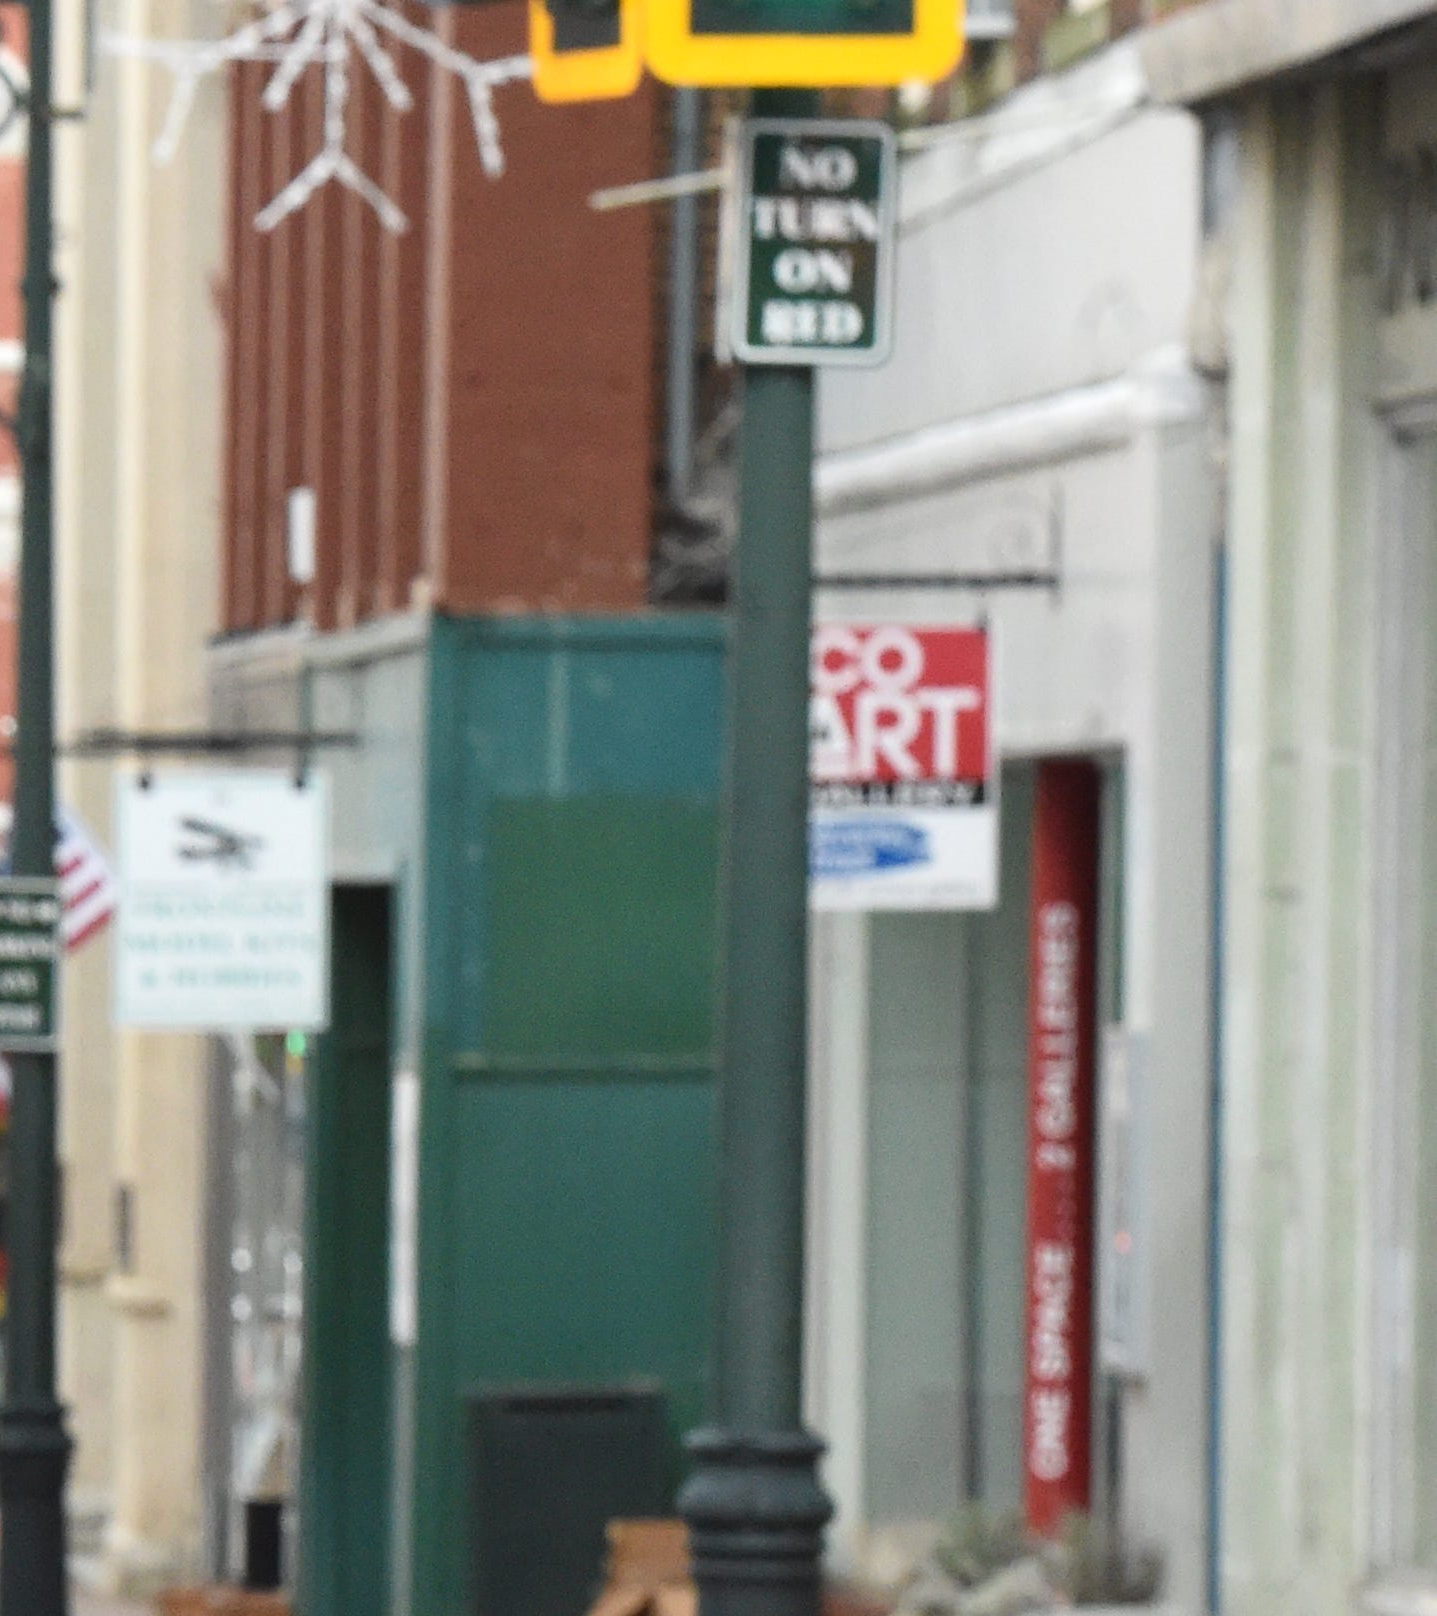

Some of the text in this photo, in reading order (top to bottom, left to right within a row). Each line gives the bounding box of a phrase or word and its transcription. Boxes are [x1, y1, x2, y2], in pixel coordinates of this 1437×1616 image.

[780, 145, 858, 190] NO
[755, 196, 879, 240] TURN
[772, 249, 854, 293] ON
[761, 299, 865, 344] RED
[809, 687, 980, 781] ART
[1033, 899, 1081, 1140] GALLERIES
[1031, 1240, 1075, 1381] SPACE
[1029, 1388, 1073, 1481] ONE
